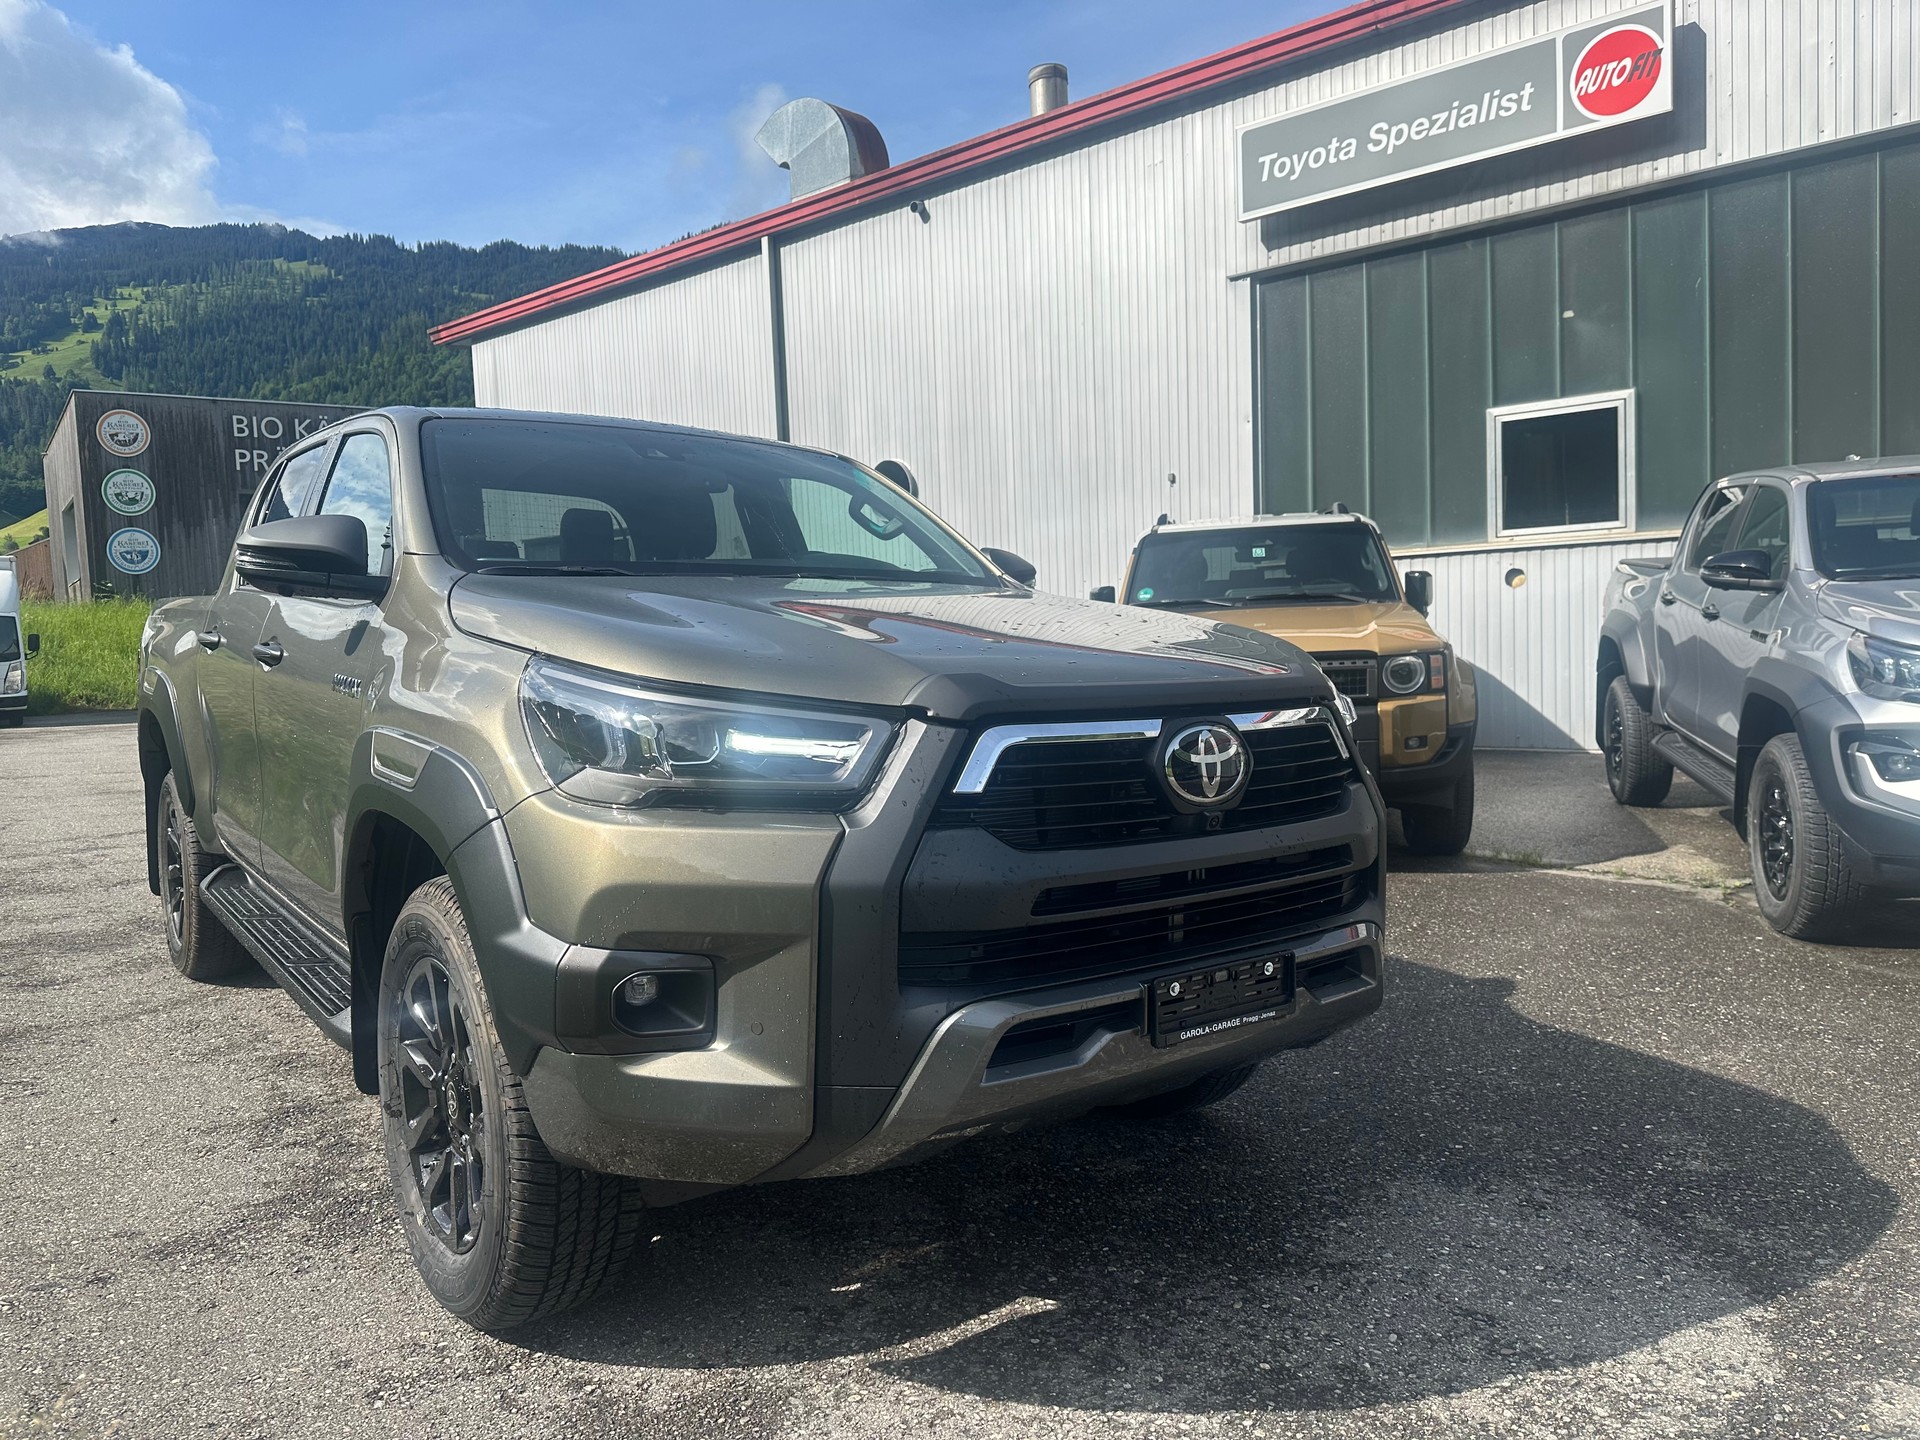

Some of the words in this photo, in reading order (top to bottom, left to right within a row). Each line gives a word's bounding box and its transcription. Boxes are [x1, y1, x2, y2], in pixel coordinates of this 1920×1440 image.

[1575, 47, 1664, 97] AUTOFIT
[1257, 136, 1357, 182] Toyota
[1366, 81, 1535, 155] Spezialist
[232, 415, 283, 439] BIO
[234, 446, 286, 472] PR
[1180, 1018, 1241, 1040] GAROLA-GARAGE
